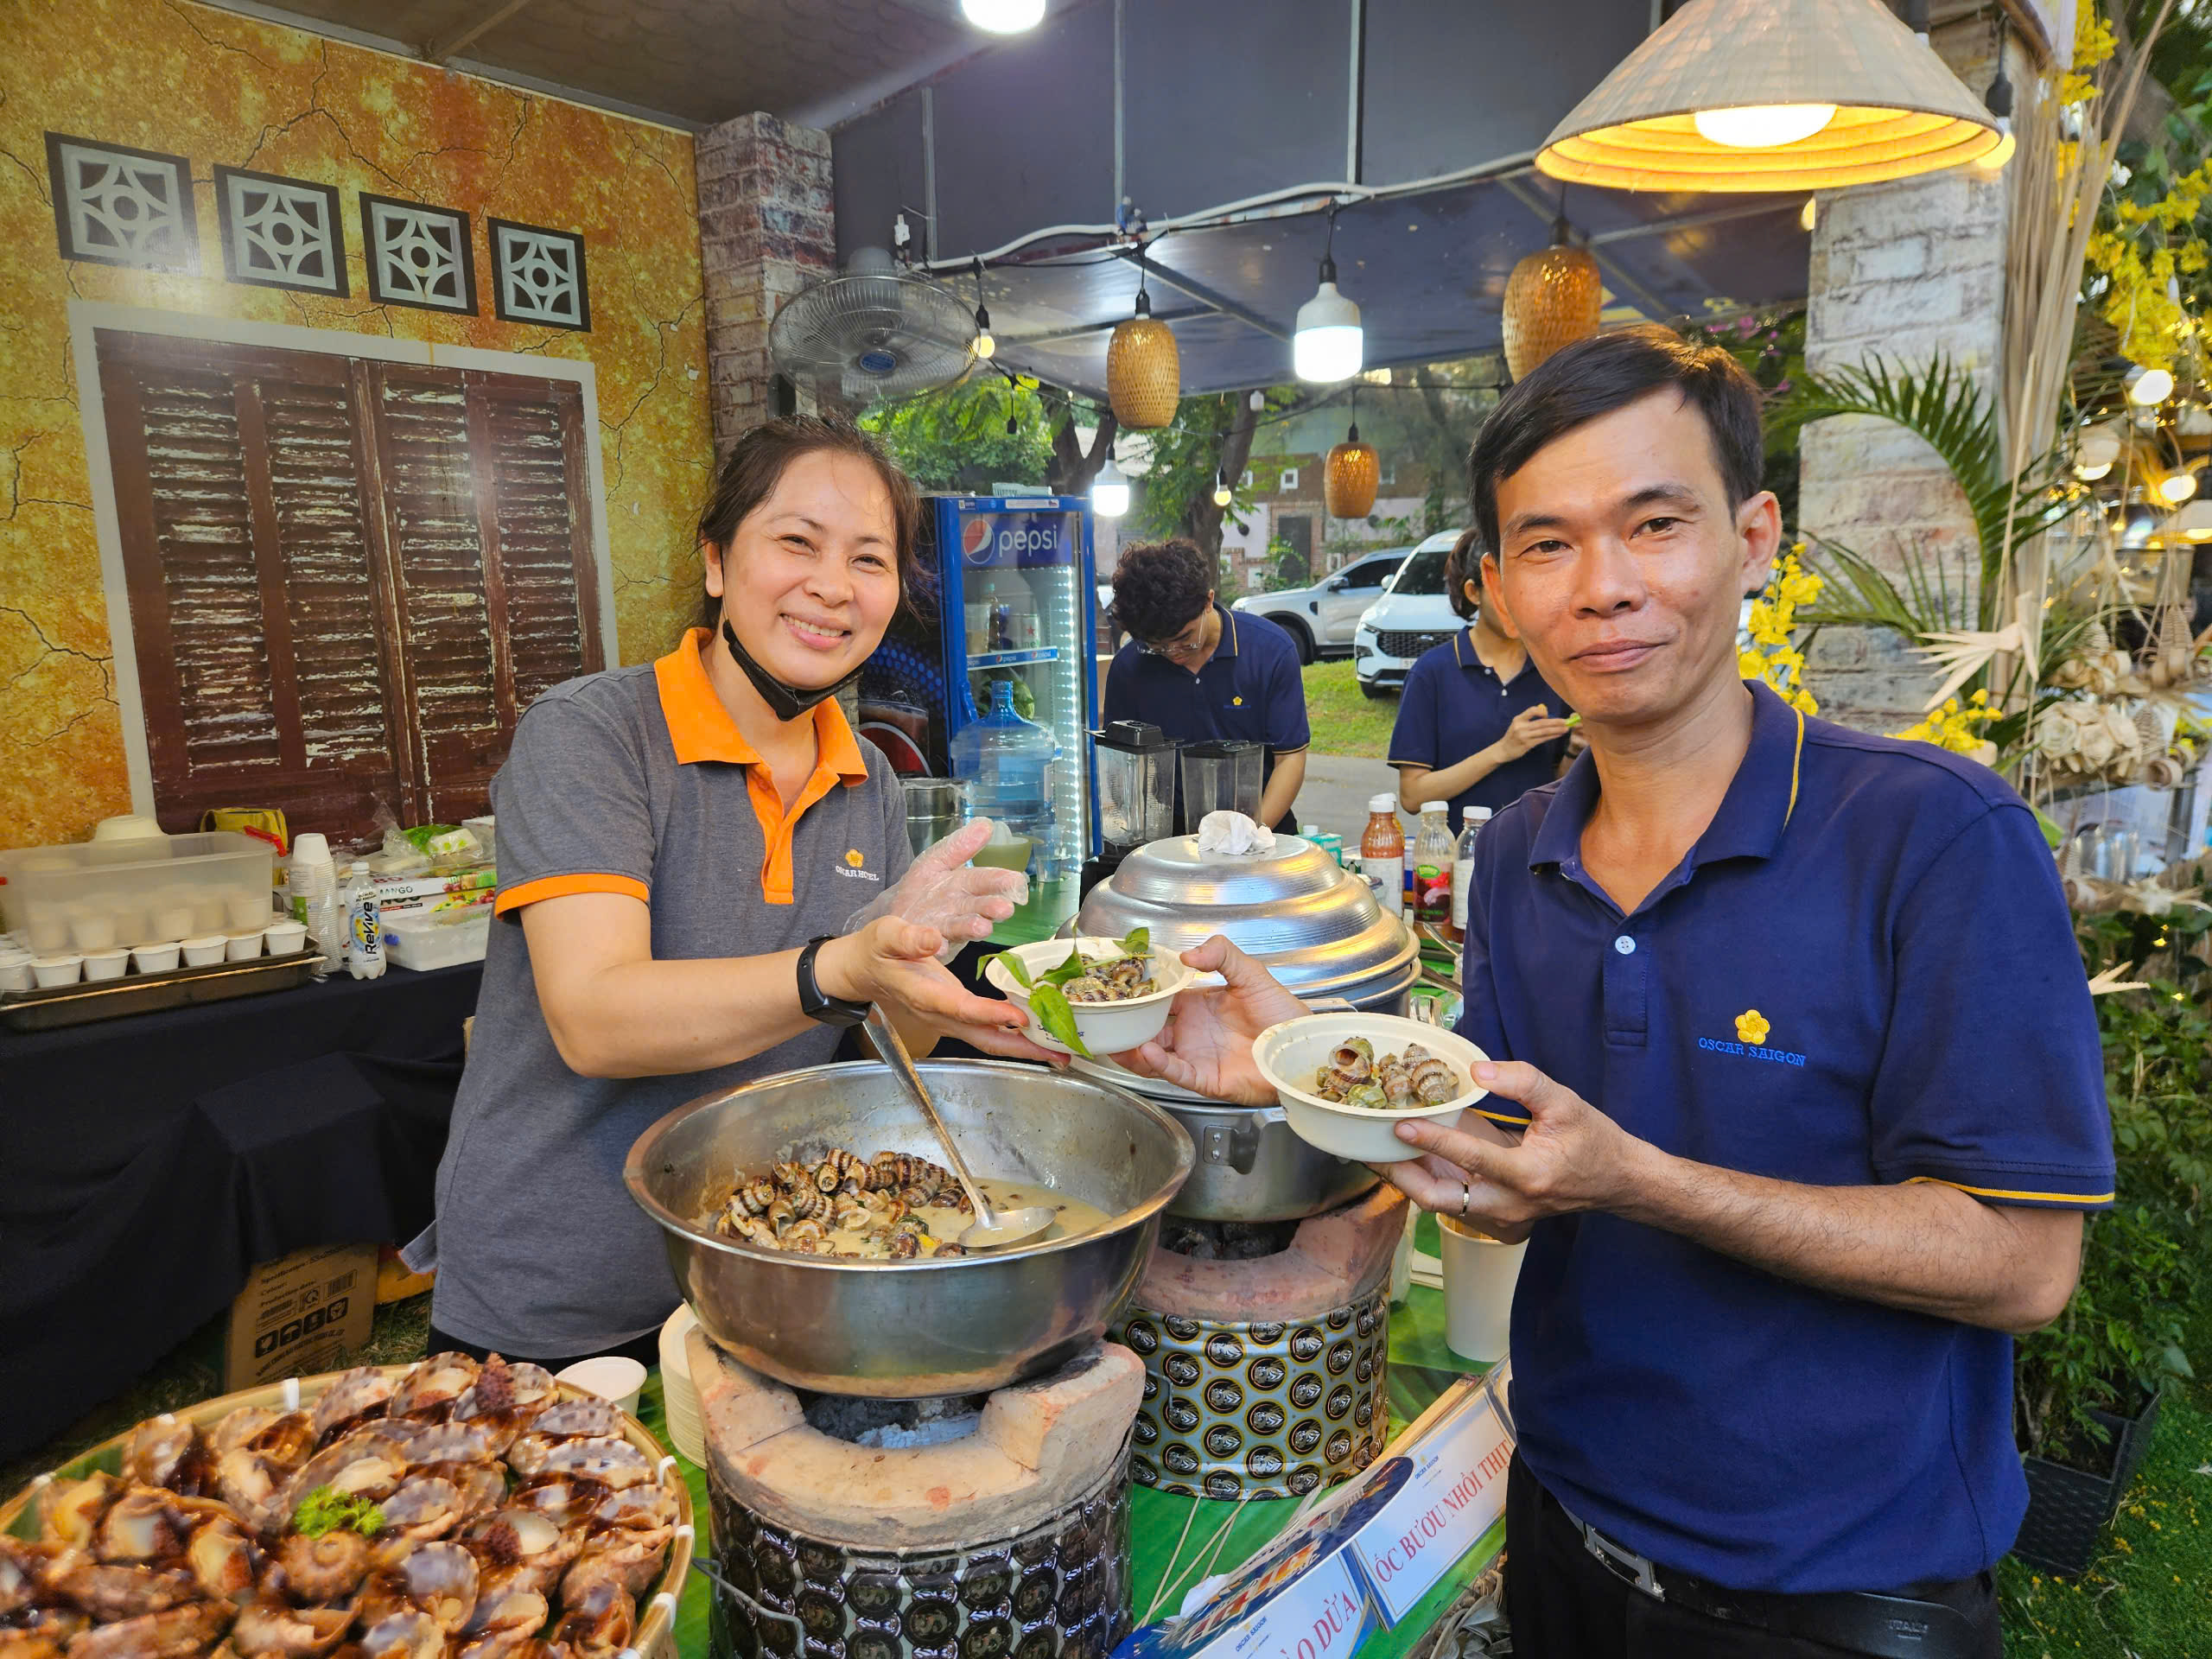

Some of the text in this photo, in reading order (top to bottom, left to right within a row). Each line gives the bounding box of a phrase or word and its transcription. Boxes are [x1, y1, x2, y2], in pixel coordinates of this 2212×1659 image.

[999, 524, 1058, 557] pepsi
[1698, 1037, 1807, 1068] OSCAR SAIGON
[1375, 1548, 1404, 1582] ỐC
[1399, 1504, 1446, 1561] BƯƠU
[1442, 1471, 1484, 1518] NHỒI
[1313, 1591, 1357, 1652] DỪA
